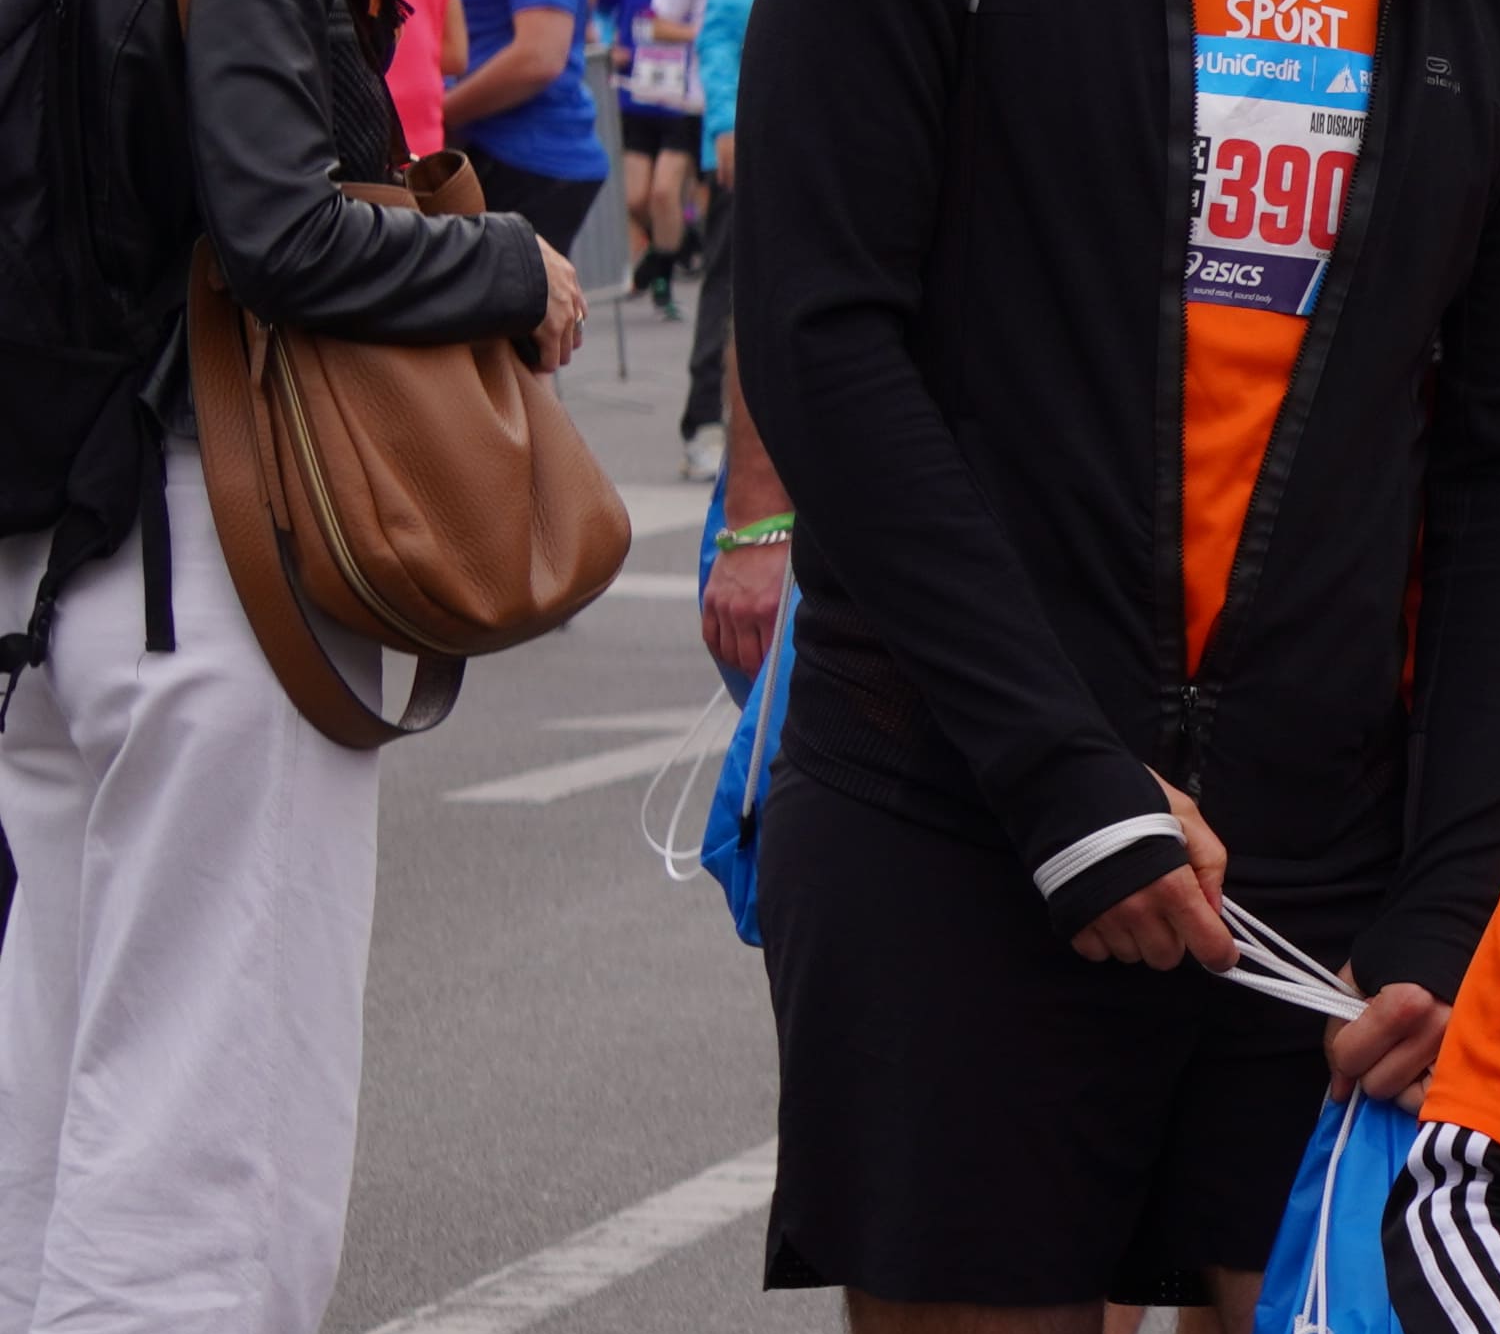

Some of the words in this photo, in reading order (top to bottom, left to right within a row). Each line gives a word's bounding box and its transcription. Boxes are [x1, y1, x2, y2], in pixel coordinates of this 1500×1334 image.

[1206, 51, 1302, 83] UniCredit
[1310, 112, 1324, 134] AIR
[1200, 259, 1264, 287] asics
